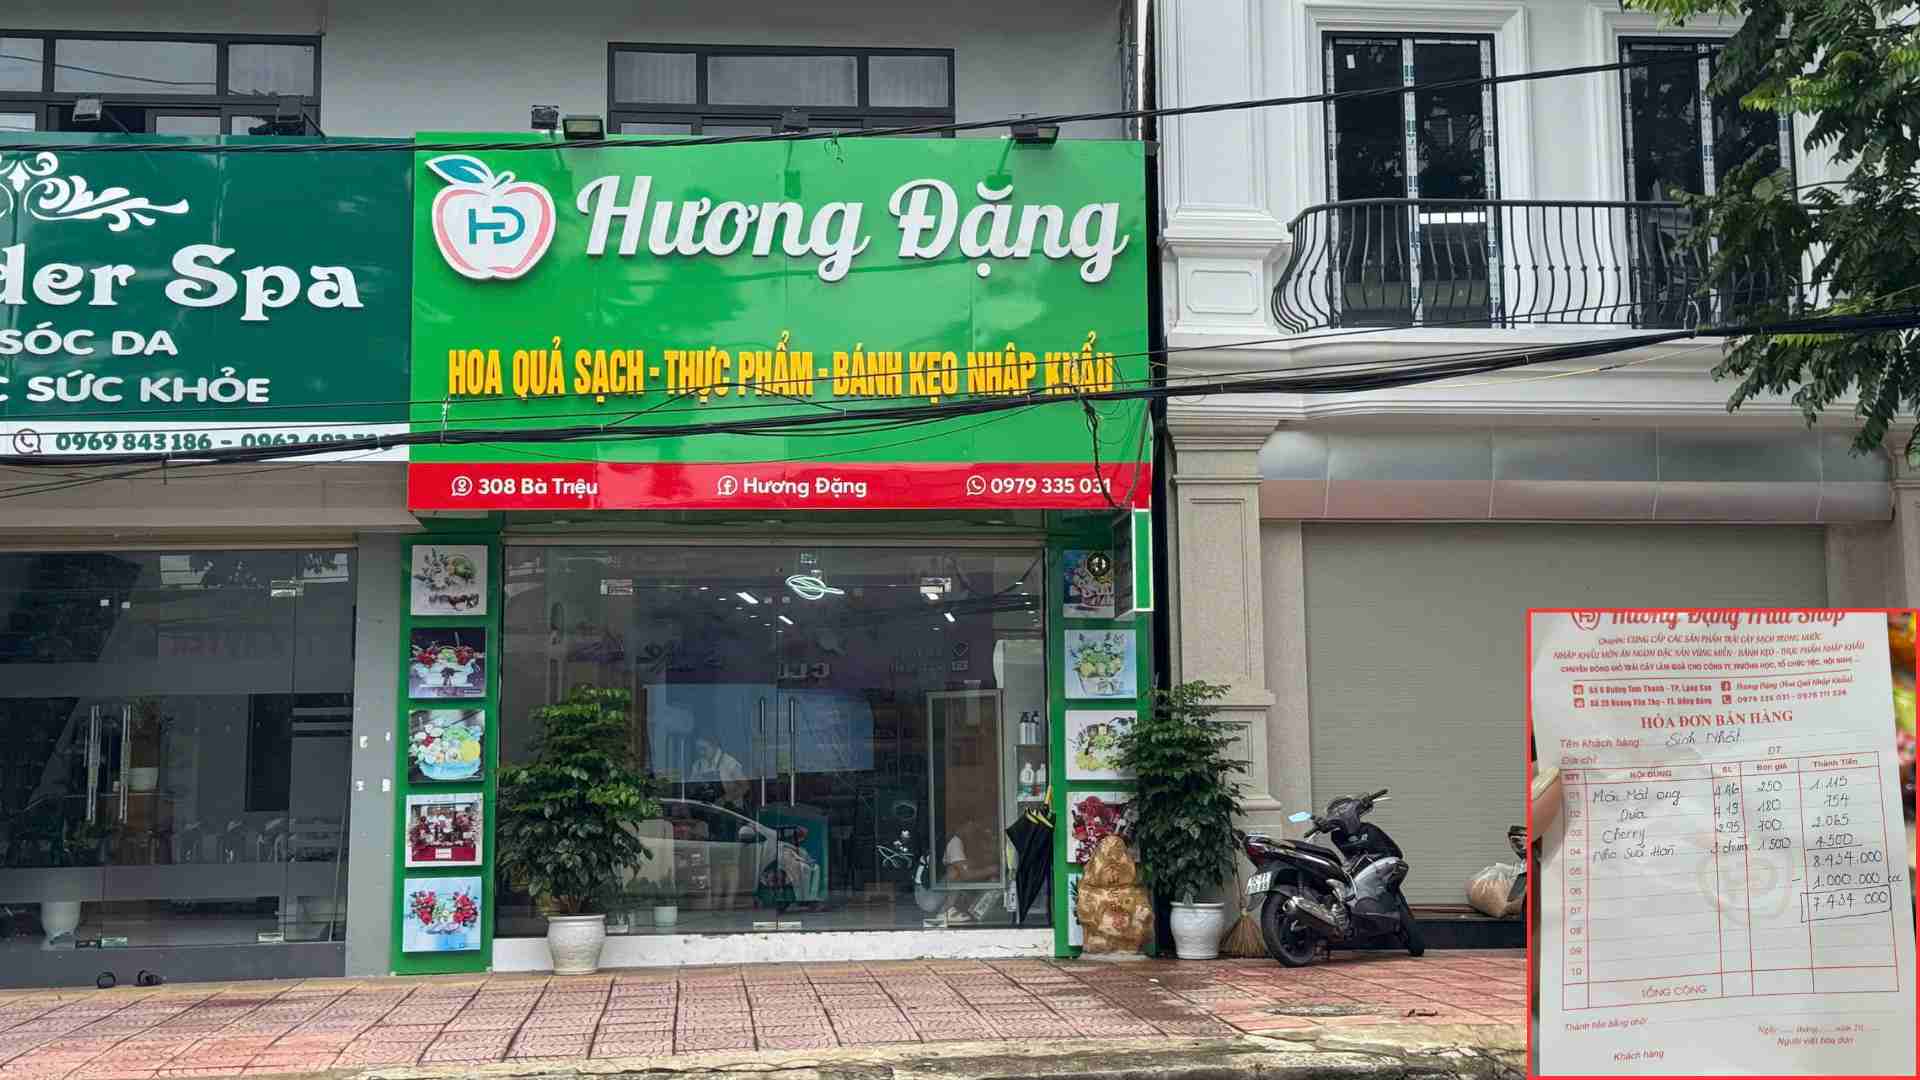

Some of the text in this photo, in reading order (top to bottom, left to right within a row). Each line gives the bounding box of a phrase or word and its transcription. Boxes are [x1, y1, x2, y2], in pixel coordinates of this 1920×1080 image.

[576, 175, 1130, 283] Hương Đặng
[165, 243, 364, 321] Spa
[112, 330, 178, 355] DA
[448, 349, 503, 395] HOA
[512, 336, 566, 400] QUẢ
[574, 349, 645, 403] SẠCH
[664, 346, 730, 404] THỰC
[738, 330, 813, 396] PHẨM
[832, 342, 903, 396] BÁNH
[909, 351, 958, 407] KẸO
[1045, 331, 1114, 395] KHẨU
[27, 369, 123, 402] SỨC
[140, 367, 270, 402] KHỎE
[56, 433, 121, 450] 0969
[122, 433, 167, 450] 843
[170, 433, 212, 450] 186
[479, 476, 598, 499] 308 Bà Triệu
[744, 475, 867, 498] Hương Đặng
[991, 478, 1111, 494] 0979 335 031
[1679, 712, 1712, 727] ĐƠN
[1750, 708, 1793, 725] HÀNG
[1560, 738, 1579, 749] Tên
